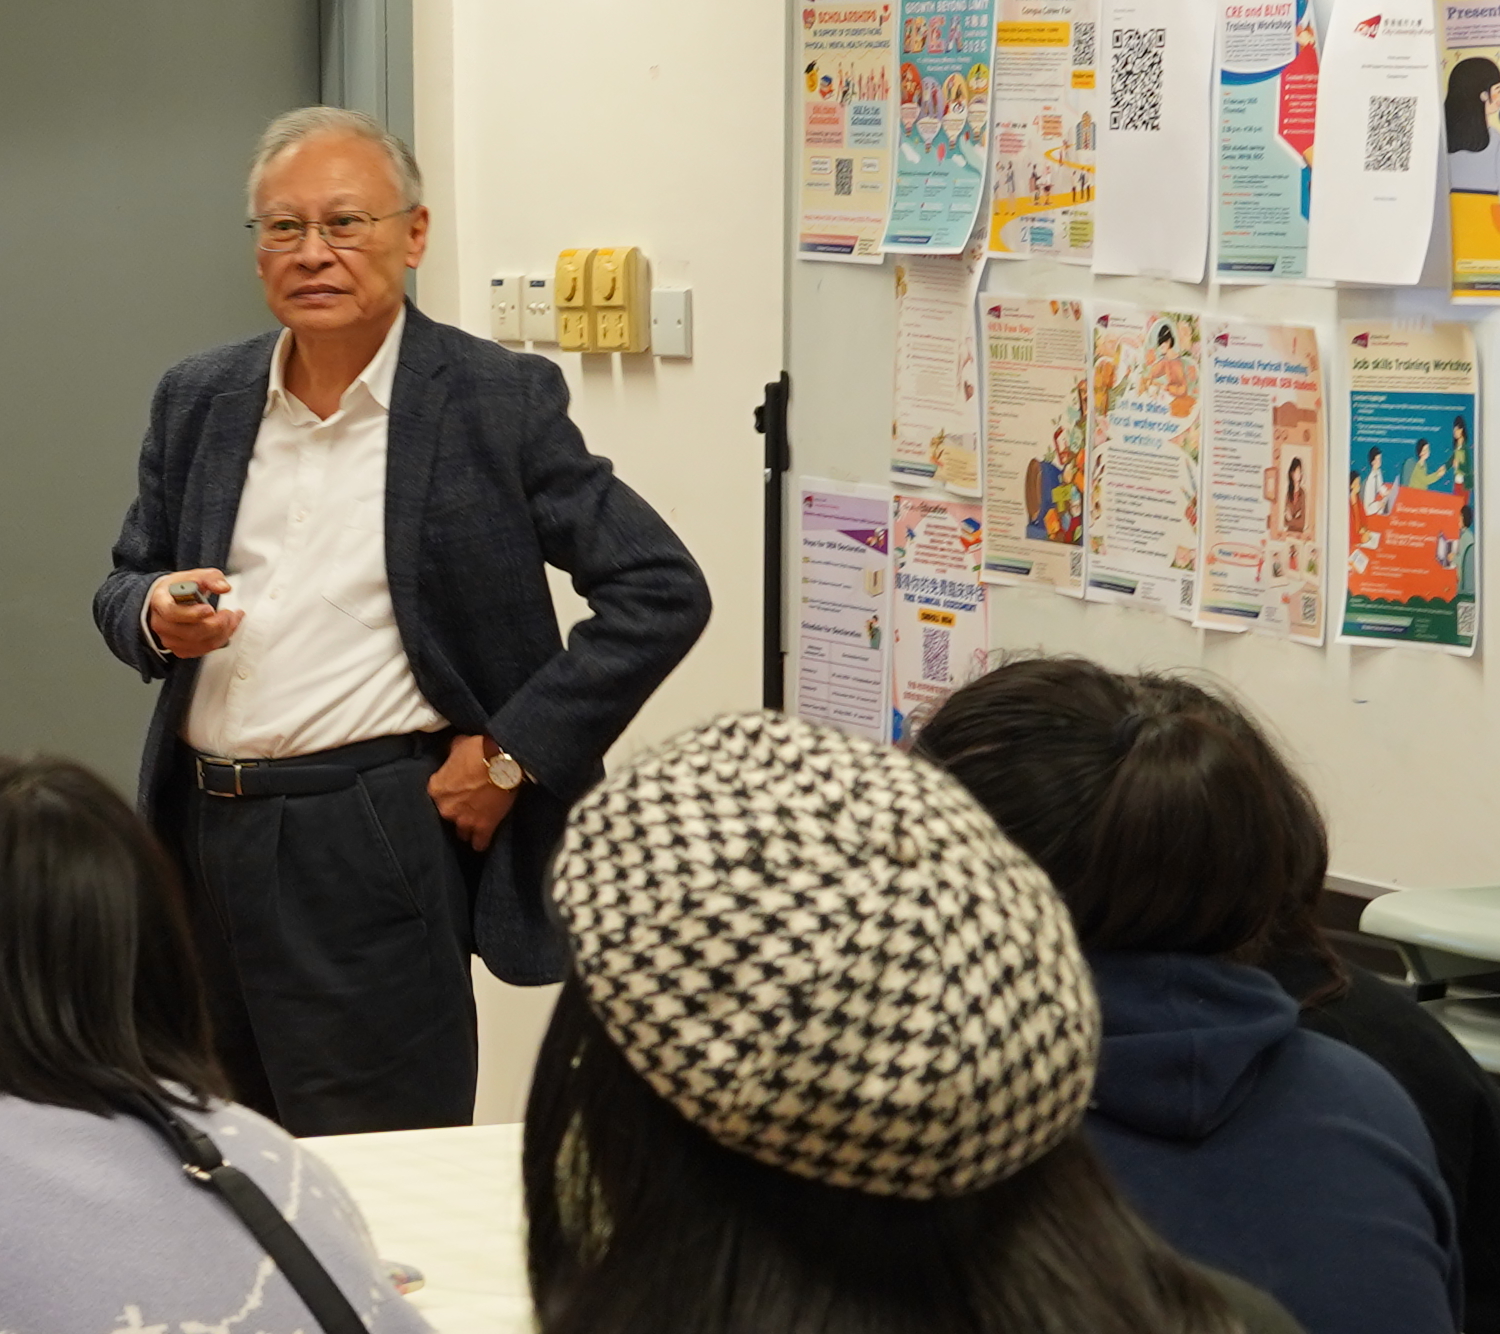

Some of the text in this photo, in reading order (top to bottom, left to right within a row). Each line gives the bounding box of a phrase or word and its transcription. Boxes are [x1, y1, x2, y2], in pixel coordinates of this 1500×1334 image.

[905, 1, 935, 14] GROWTH
[937, 0, 967, 13] BEYOND
[1225, 4, 1243, 19] CRE
[1245, 4, 1262, 18] and
[1225, 19, 1292, 34] Training Workshop
[1352, 358, 1368, 372] Job
[1394, 358, 1430, 374] Training
[1433, 359, 1472, 374] Workshop
